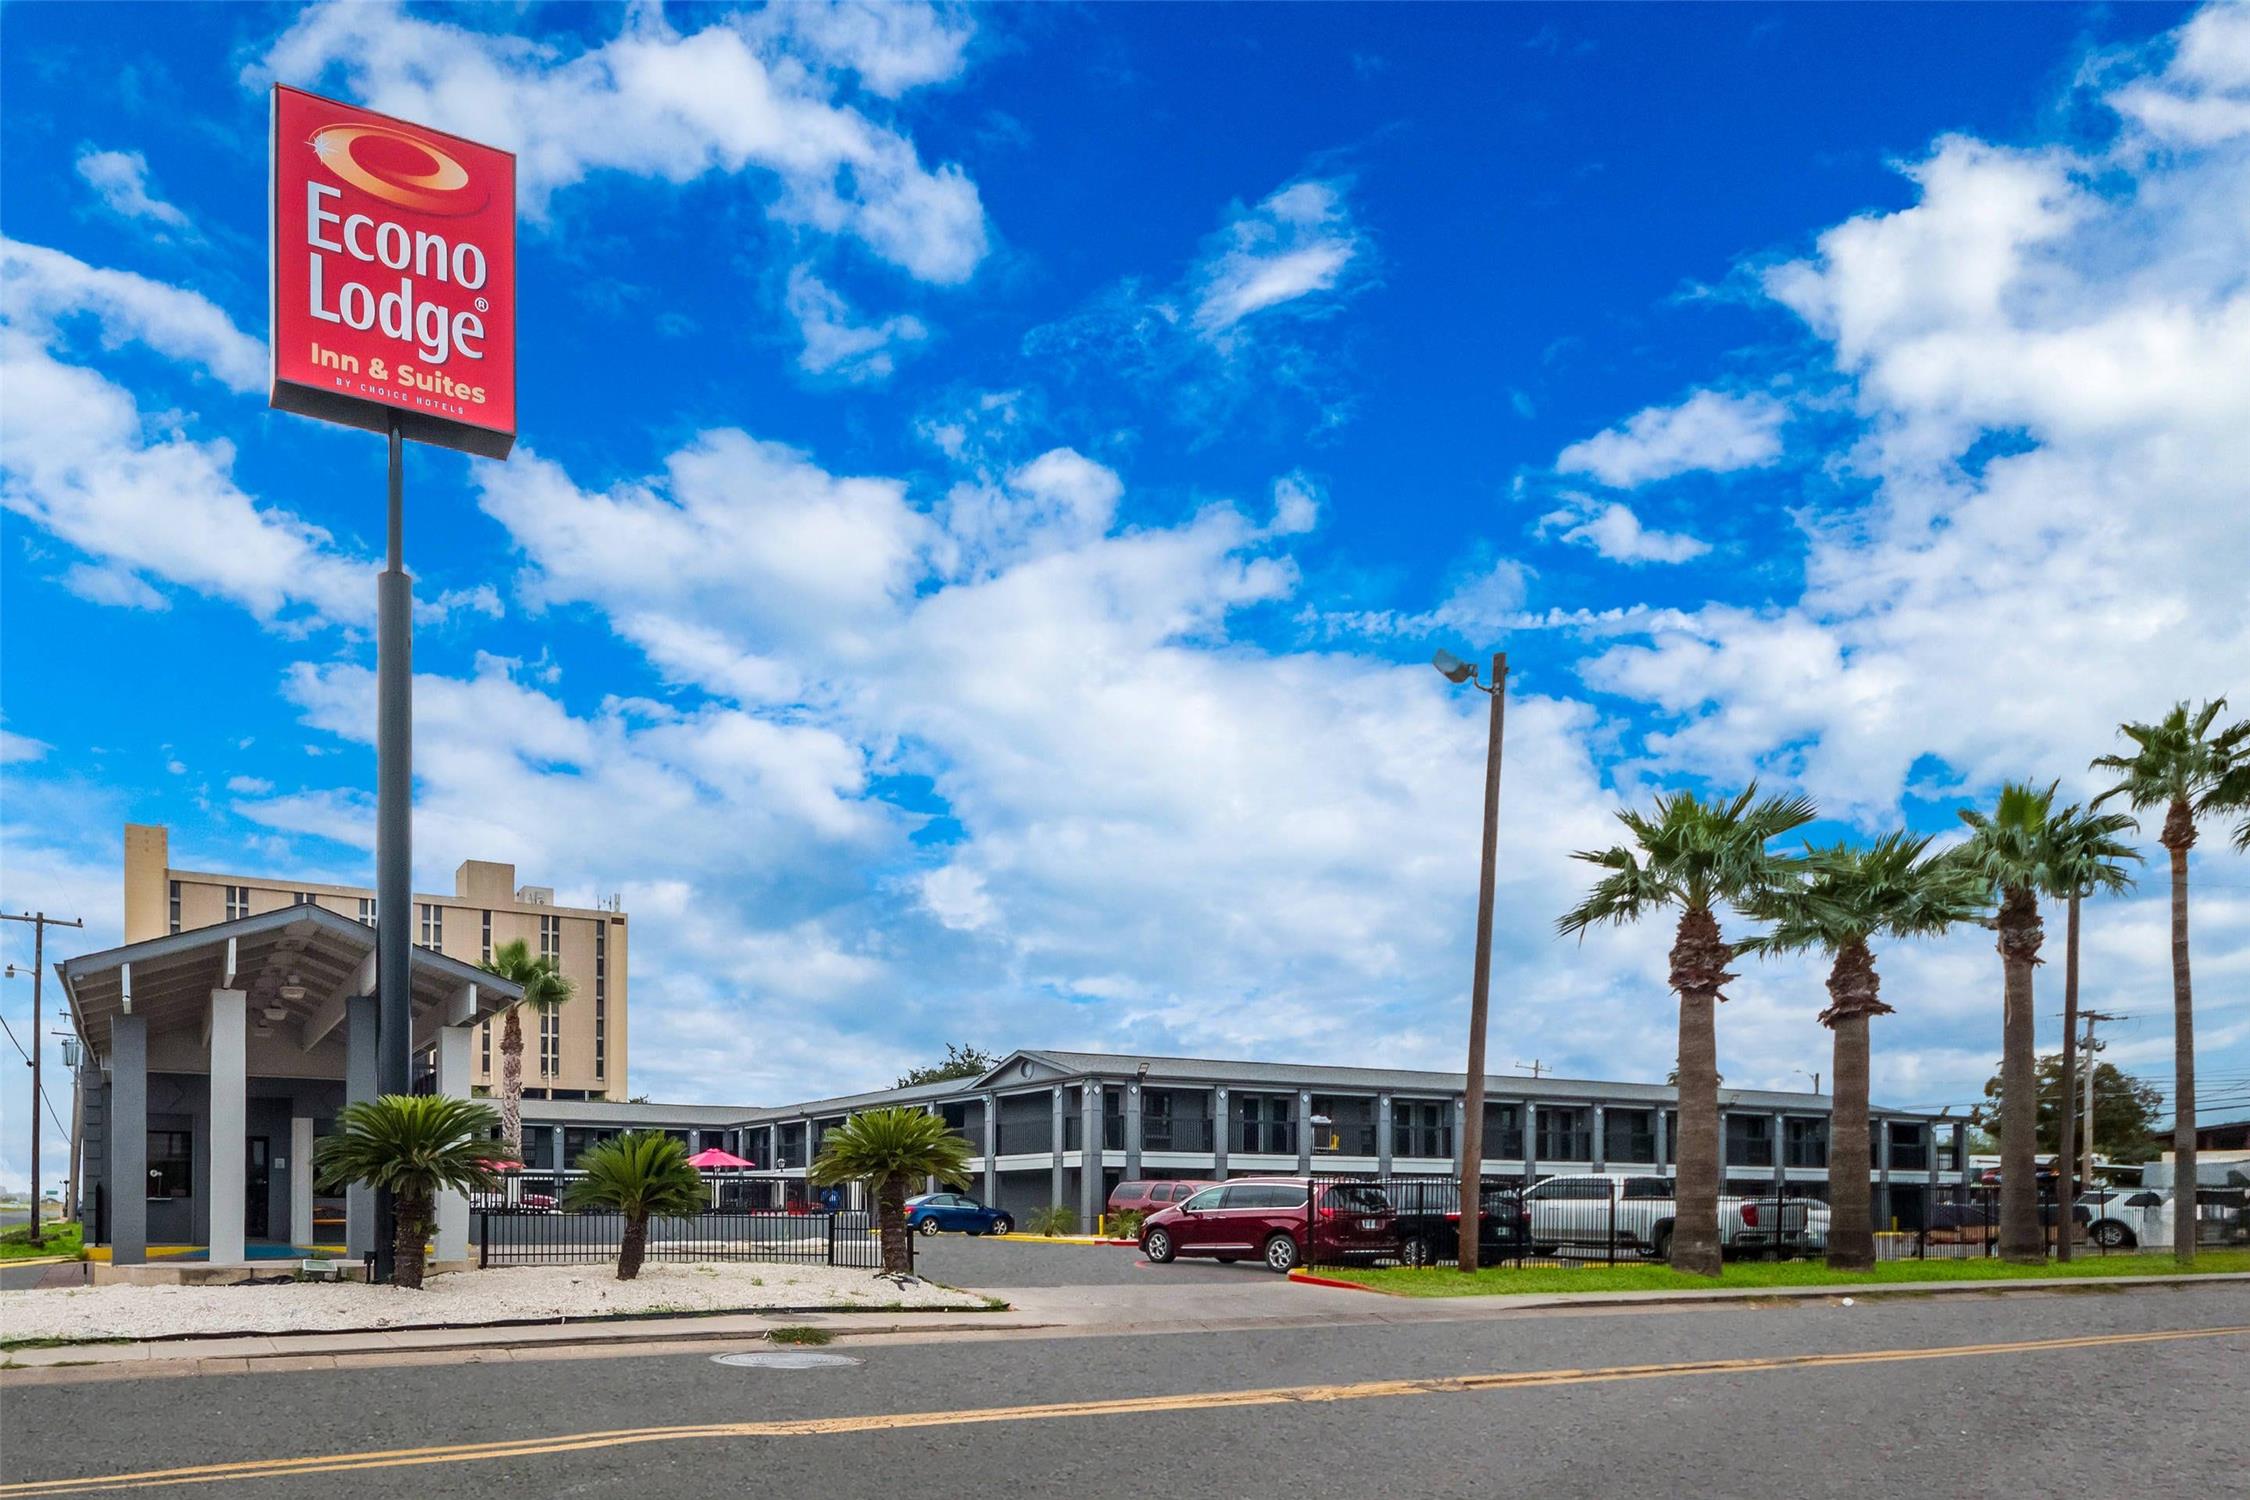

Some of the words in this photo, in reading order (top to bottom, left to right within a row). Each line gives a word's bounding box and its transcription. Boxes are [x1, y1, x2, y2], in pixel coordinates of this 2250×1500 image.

[307, 180, 487, 290] Econo
[311, 342, 359, 374] Inn
[368, 357, 389, 381] &
[397, 364, 486, 404] Suites
[335, 377, 351, 388] BY
[360, 383, 408, 401] CHOICE
[416, 396, 464, 415] HOTELS
